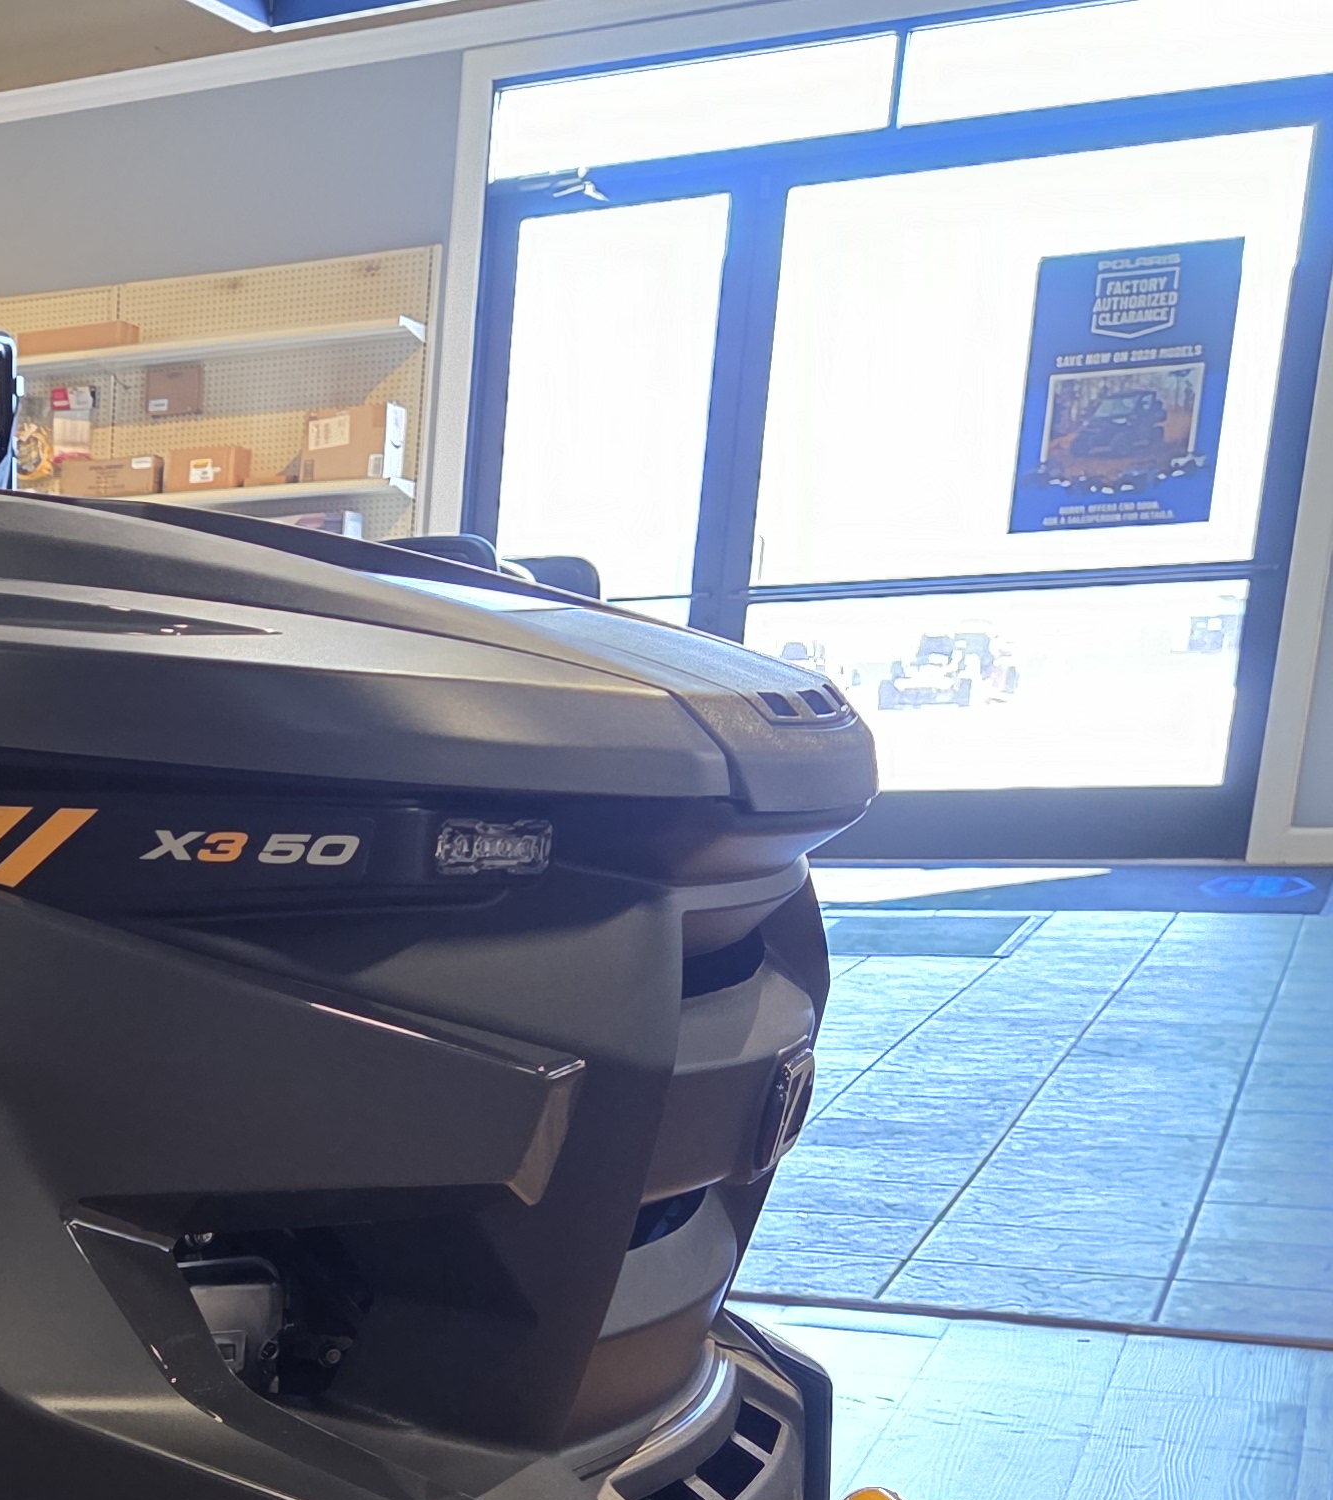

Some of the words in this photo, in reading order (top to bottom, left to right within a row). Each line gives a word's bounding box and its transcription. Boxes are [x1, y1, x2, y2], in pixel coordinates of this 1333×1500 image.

[1097, 254, 1181, 271] POLARIS
[1106, 276, 1168, 296] FACTORY
[1093, 291, 1178, 312] AUTHORIZED
[1098, 307, 1168, 326] CLEARANCE
[1056, 354, 1084, 368] SAVE
[1085, 352, 1111, 365] NOW
[1113, 351, 1129, 363] ON
